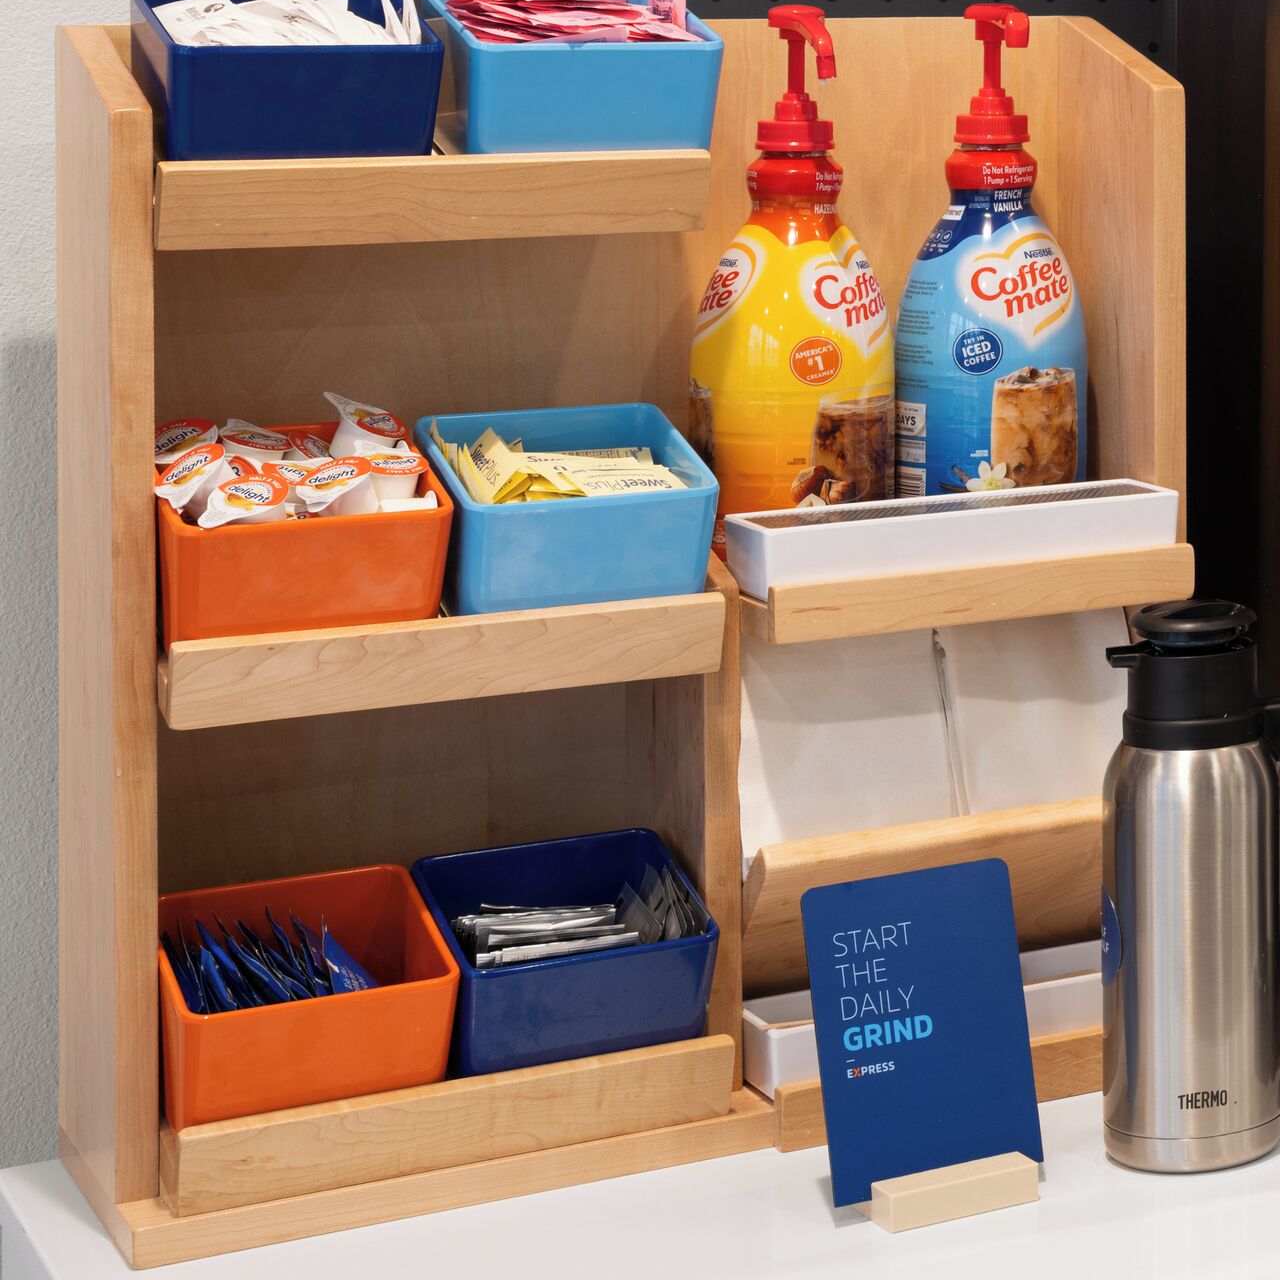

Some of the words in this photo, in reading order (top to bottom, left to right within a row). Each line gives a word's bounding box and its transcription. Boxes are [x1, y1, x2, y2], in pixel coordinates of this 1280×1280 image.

[982, 166, 991, 175] Do
[991, 166, 1003, 175] Not
[1004, 165, 1034, 176] Refrigerate
[987, 177, 1004, 186] Pump
[994, 188, 1023, 200] FRENCH
[993, 201, 1023, 213] VANILLA
[970, 257, 1063, 301] Coffee
[1003, 274, 1069, 318] mate
[961, 341, 992, 358] ICED
[963, 337, 976, 345] TRY
[795, 344, 834, 360] AMERICA'S
[963, 352, 996, 367] COFFEE
[166, 455, 209, 482] delight
[308, 469, 356, 484] delight
[228, 485, 270, 503] delight
[832, 921, 912, 957] START
[835, 958, 888, 988] THE
[840, 985, 914, 1021] DAILY
[843, 1014, 933, 1052] GRIND
[846, 1061, 896, 1080] EXPRESS
[1178, 1089, 1228, 1110] THERMO
